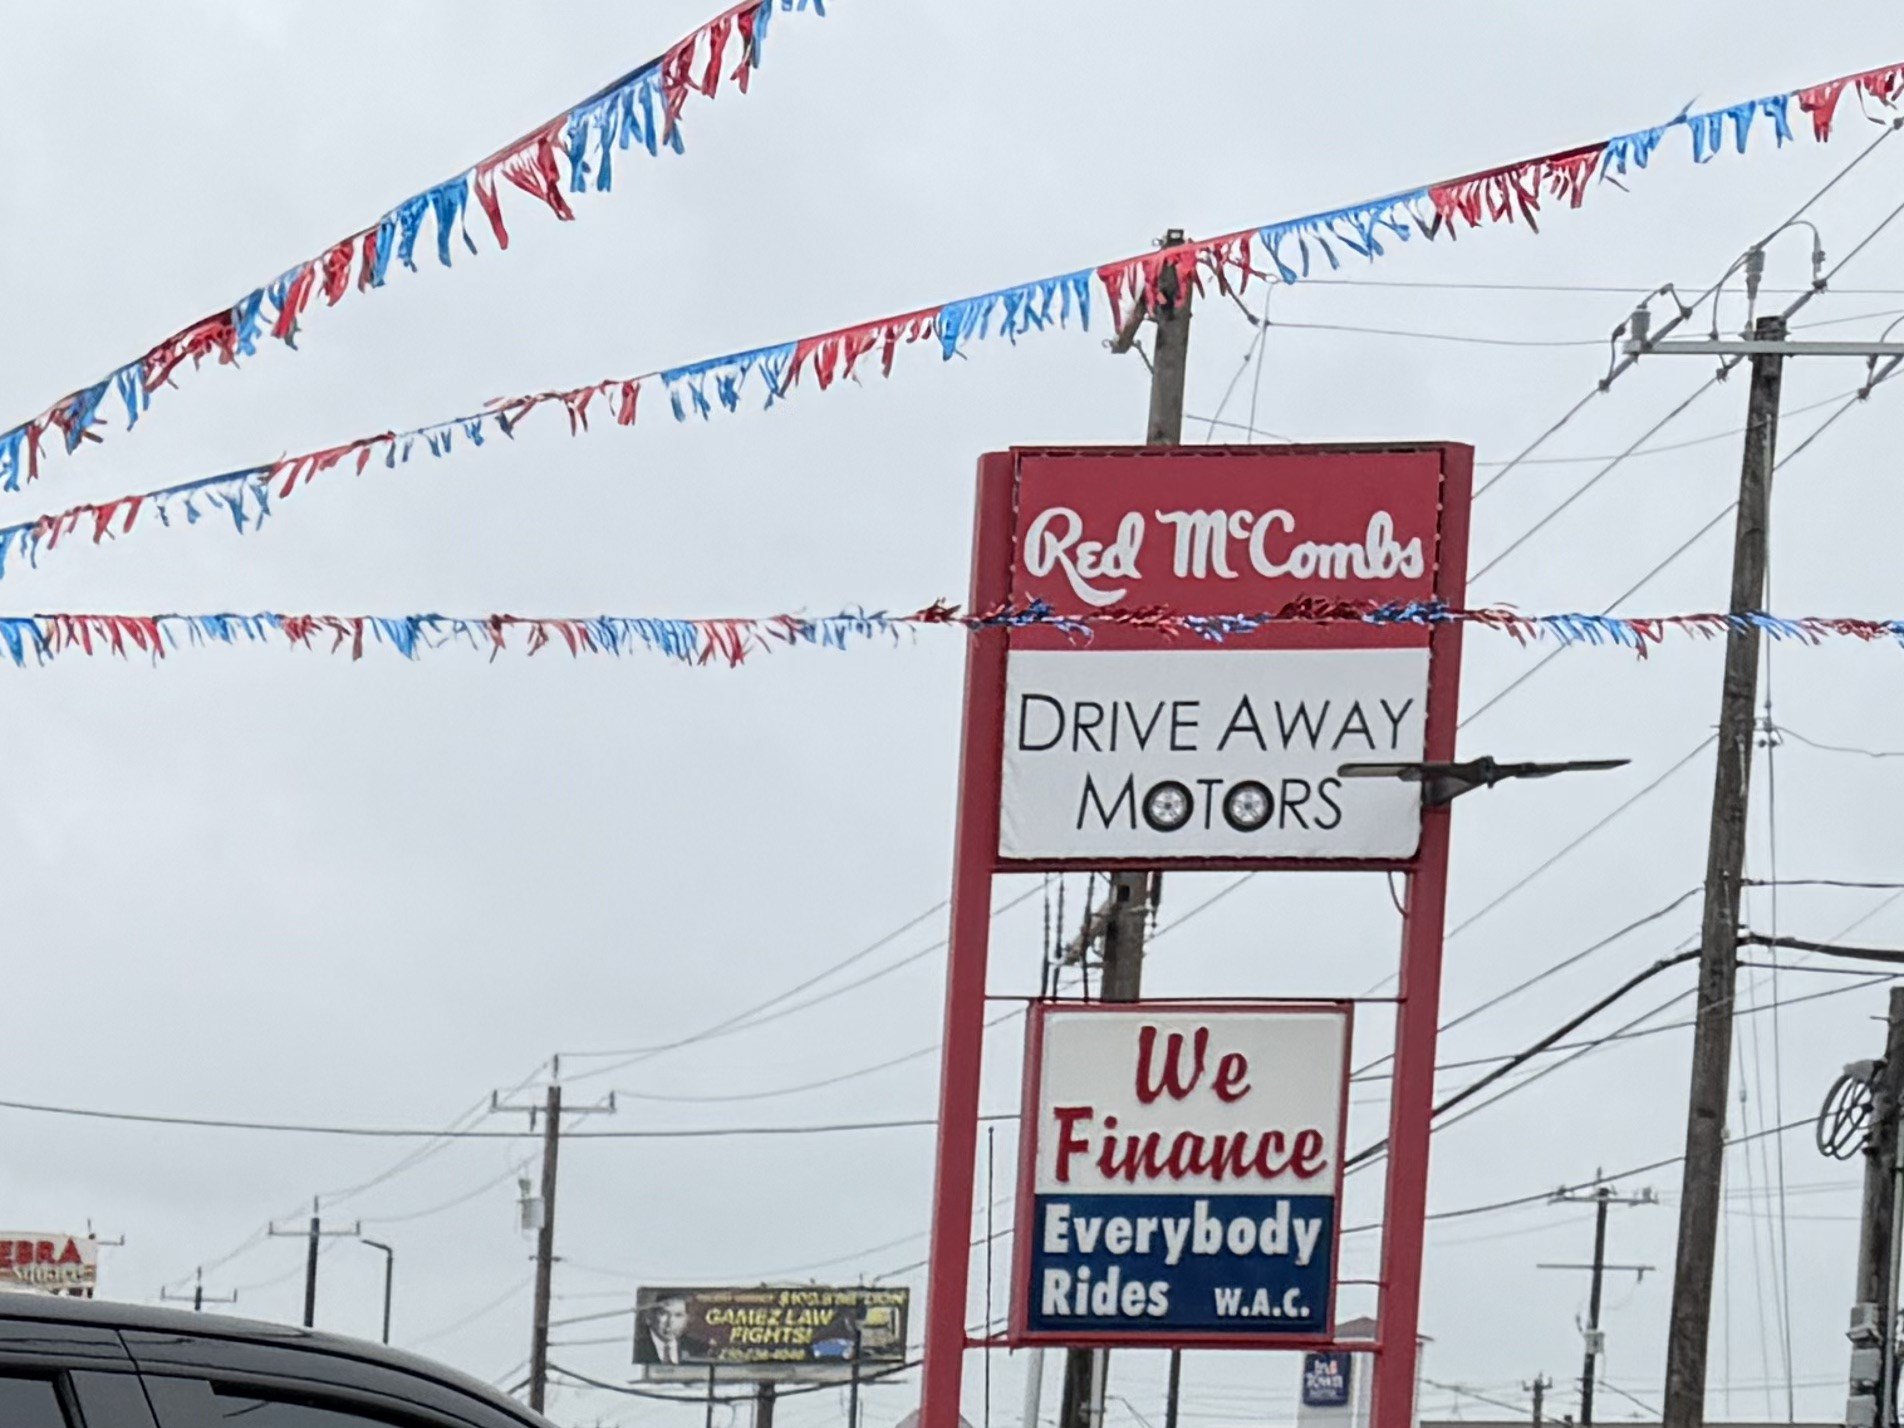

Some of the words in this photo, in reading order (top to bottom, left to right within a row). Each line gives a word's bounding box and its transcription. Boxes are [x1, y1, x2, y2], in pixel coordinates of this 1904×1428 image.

[1024, 506, 1145, 606] Red
[1155, 508, 1425, 580] McCombs
[1018, 693, 1201, 752] DRIVE
[1217, 693, 1414, 752] AWAY
[1076, 771, 1343, 833] MOTORS
[1135, 1025, 1252, 1105] We
[1052, 1105, 1328, 1184] Finance
[1043, 1200, 1323, 1267] Everybody
[785, 1308, 835, 1325] LAW
[1041, 1265, 1170, 1318] Rides
[1214, 1286, 1311, 1318] W.A.C.
